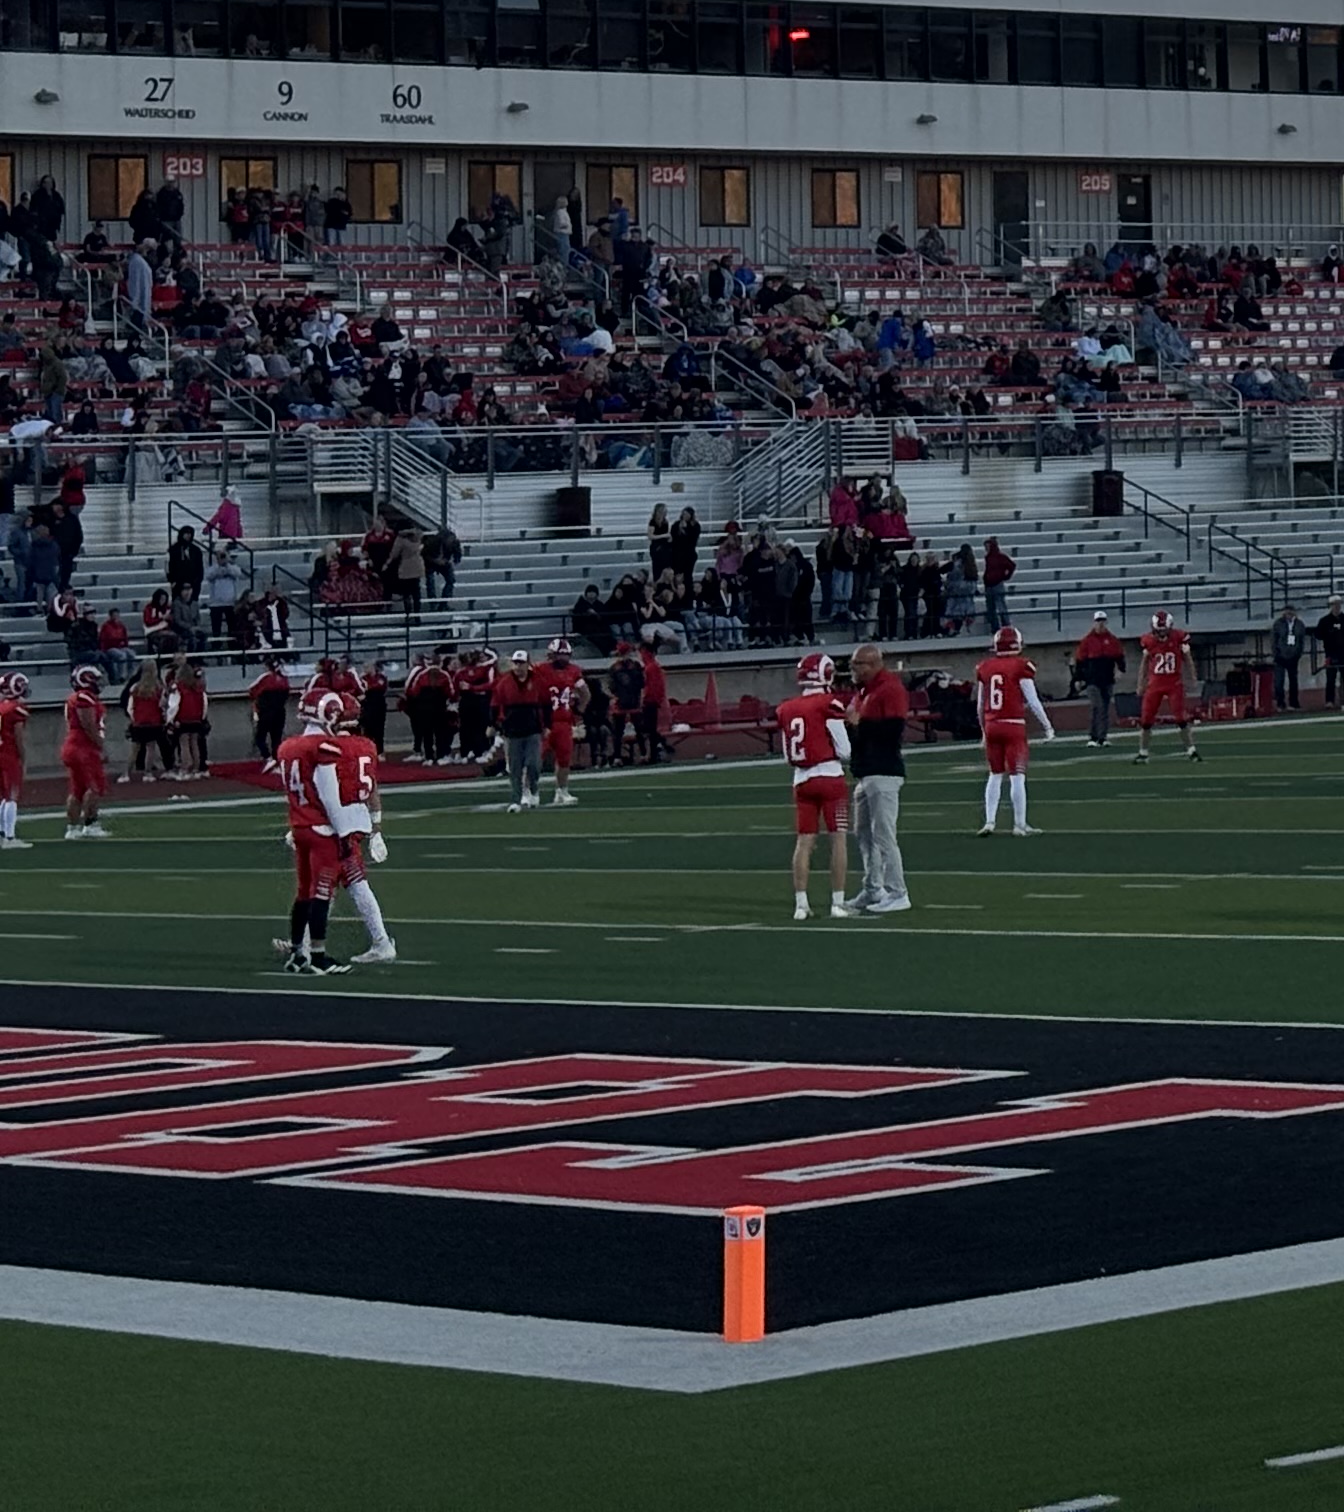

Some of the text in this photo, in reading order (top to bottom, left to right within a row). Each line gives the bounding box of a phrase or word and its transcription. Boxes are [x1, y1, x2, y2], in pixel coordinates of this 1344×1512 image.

[144, 78, 174, 102] 27
[278, 81, 293, 105] 9
[392, 85, 421, 109] 60
[263, 110, 309, 123] CANNON
[166, 157, 204, 176] 203
[652, 166, 685, 184] 204
[1082, 175, 1110, 190] 205
[990, 674, 1004, 710] 6
[790, 717, 806, 762] 2
[358, 755, 374, 801] 5
